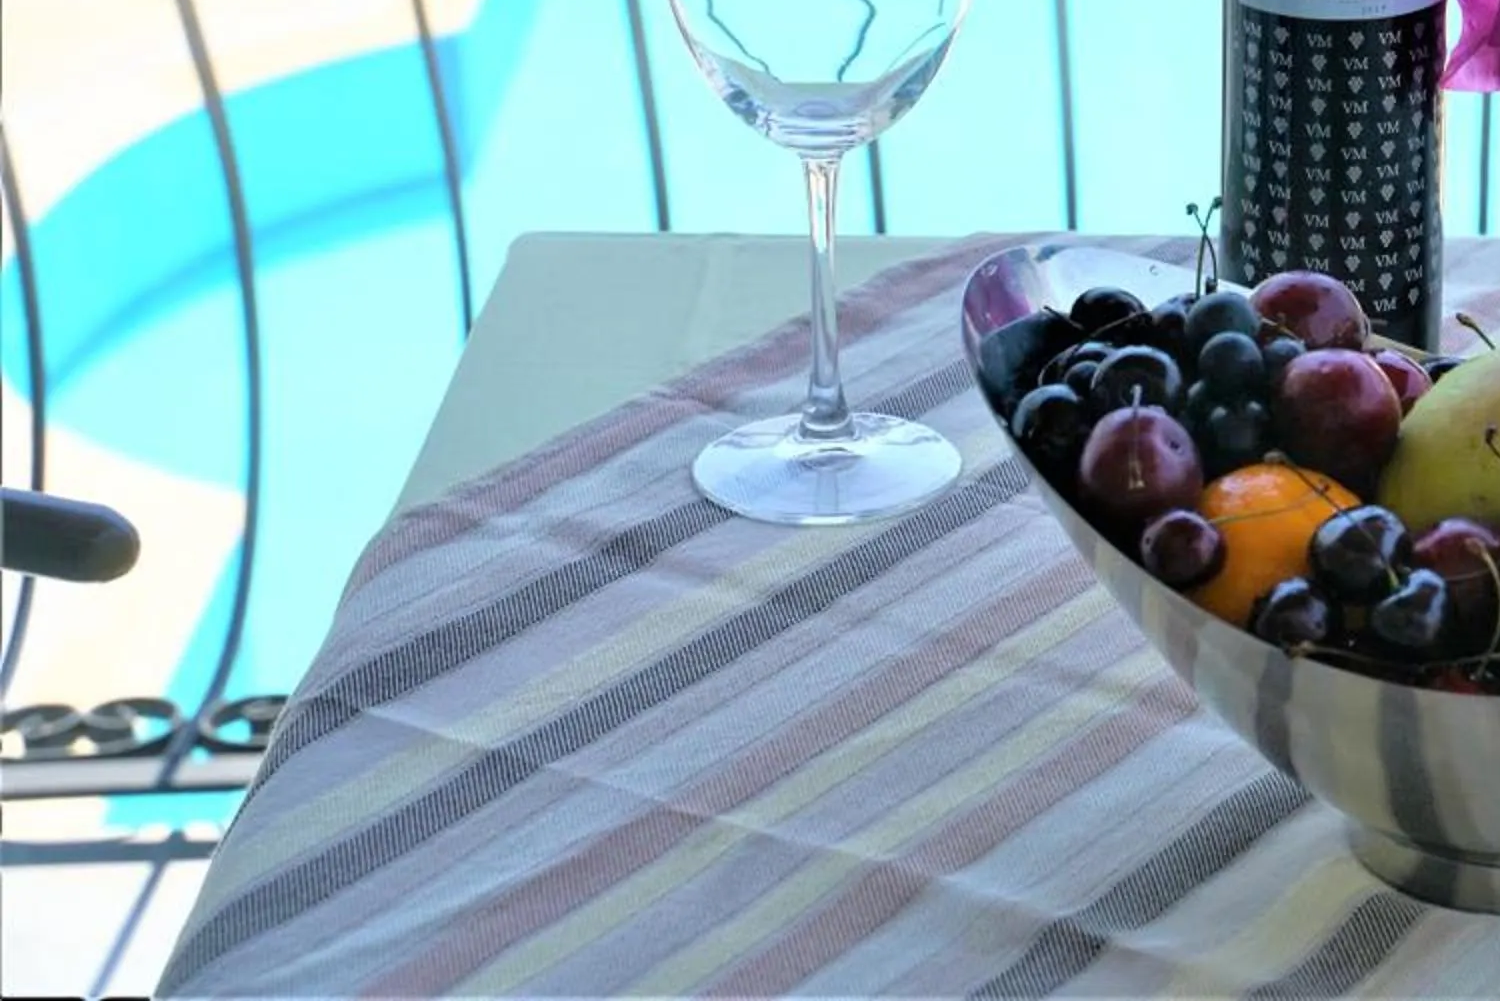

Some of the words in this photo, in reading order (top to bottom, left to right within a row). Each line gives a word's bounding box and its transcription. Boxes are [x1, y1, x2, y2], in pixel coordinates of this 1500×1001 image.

[1307, 33, 1333, 48] VM
[1379, 31, 1401, 46] VM
[1269, 51, 1292, 69] VM
[1343, 57, 1369, 71] VM
[1307, 78, 1332, 93] VM
[1378, 75, 1401, 89] VM
[1268, 95, 1292, 112] VM
[1343, 101, 1368, 115] VM
[1306, 124, 1331, 138] VM
[1377, 122, 1400, 135] VM
[1268, 140, 1291, 157] VM
[1342, 147, 1367, 160] VM
[1305, 168, 1331, 182] VM
[1376, 164, 1400, 179] VM
[1268, 183, 1291, 200] VM
[1341, 190, 1367, 204] VM
[1304, 214, 1329, 228] VM
[1375, 210, 1399, 225] VM
[1267, 230, 1290, 247] VM
[1340, 236, 1365, 250] VM
[1305, 258, 1329, 271] VM
[1375, 253, 1398, 268] VM
[1373, 298, 1397, 312] VM
